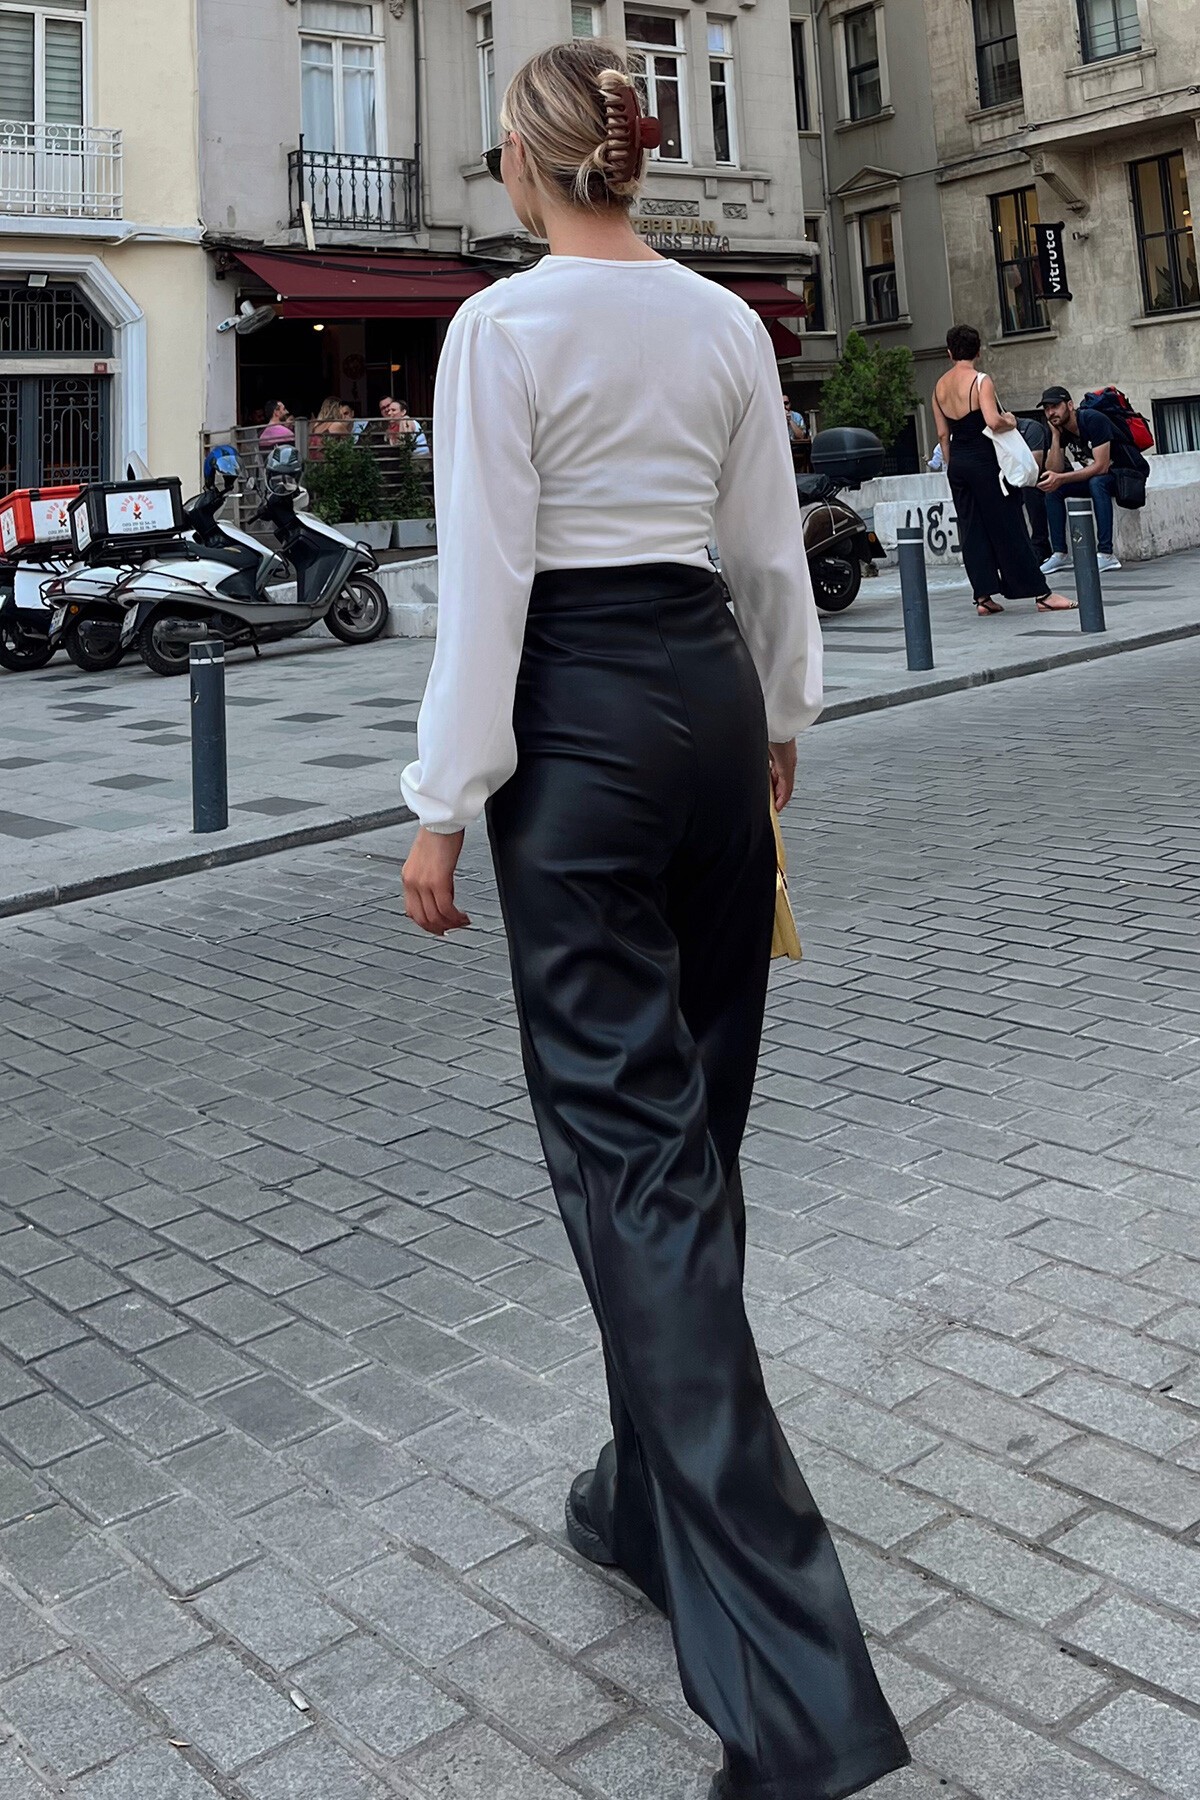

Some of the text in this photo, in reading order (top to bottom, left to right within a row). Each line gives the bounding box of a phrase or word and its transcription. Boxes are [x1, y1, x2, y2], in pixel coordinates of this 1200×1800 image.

[677, 219, 714, 235] HAN
[646, 231, 730, 253] MISS PIZZA
[1046, 230, 1061, 293] vitruta
